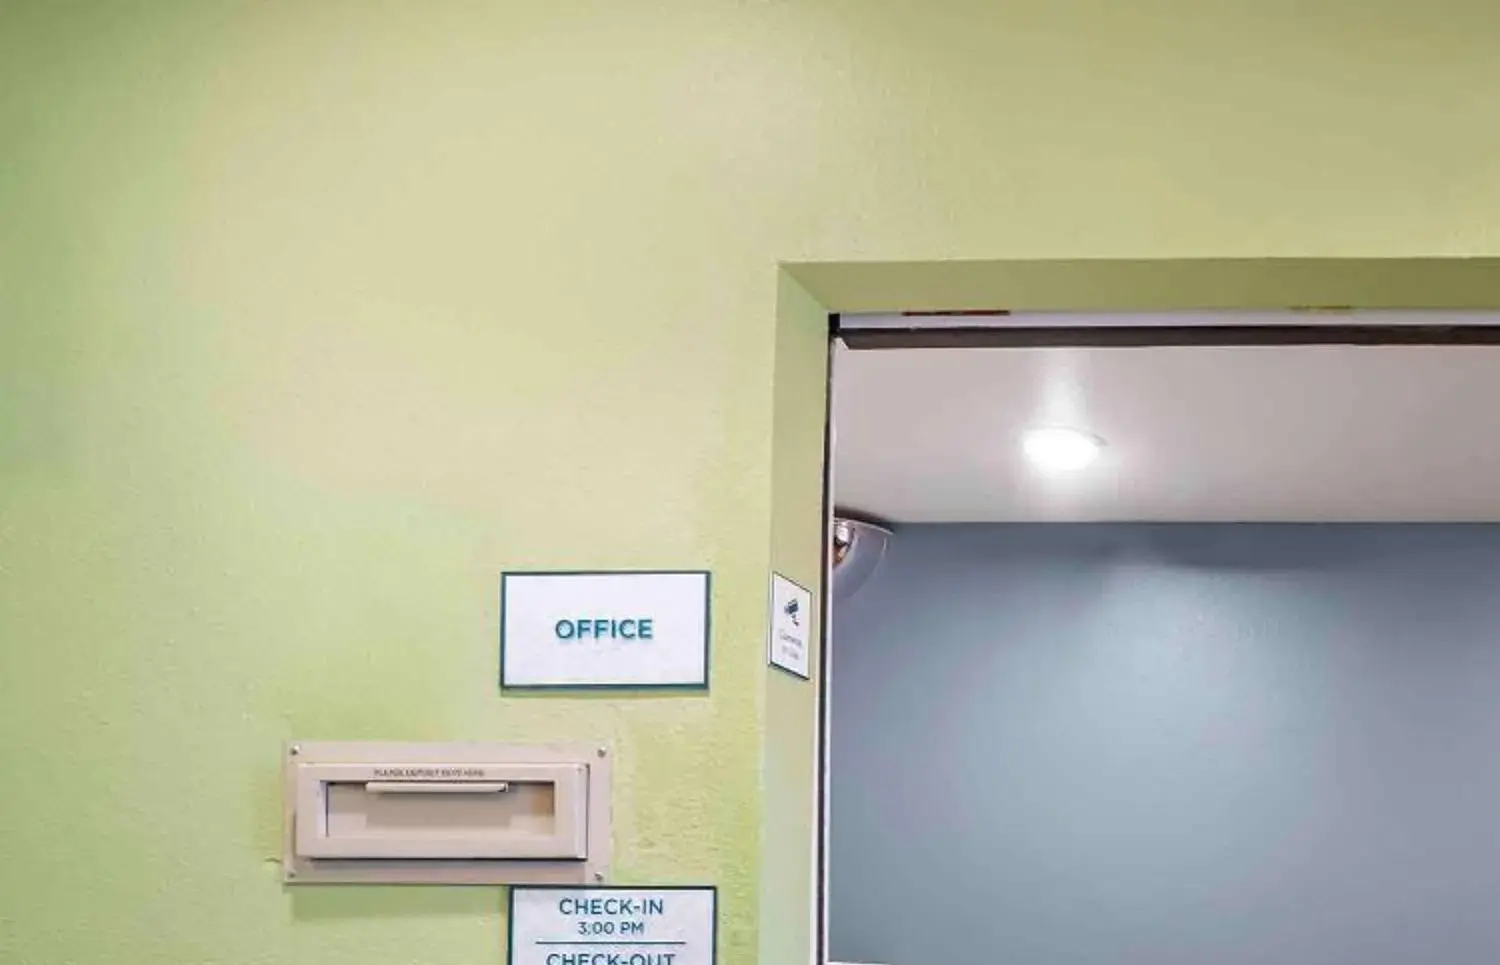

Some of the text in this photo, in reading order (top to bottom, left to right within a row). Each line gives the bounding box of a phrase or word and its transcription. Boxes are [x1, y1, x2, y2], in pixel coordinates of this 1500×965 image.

[555, 618, 653, 639] OFFICE
[559, 898, 664, 916] CHECK-IN
[577, 921, 645, 936] 3:00 PM
